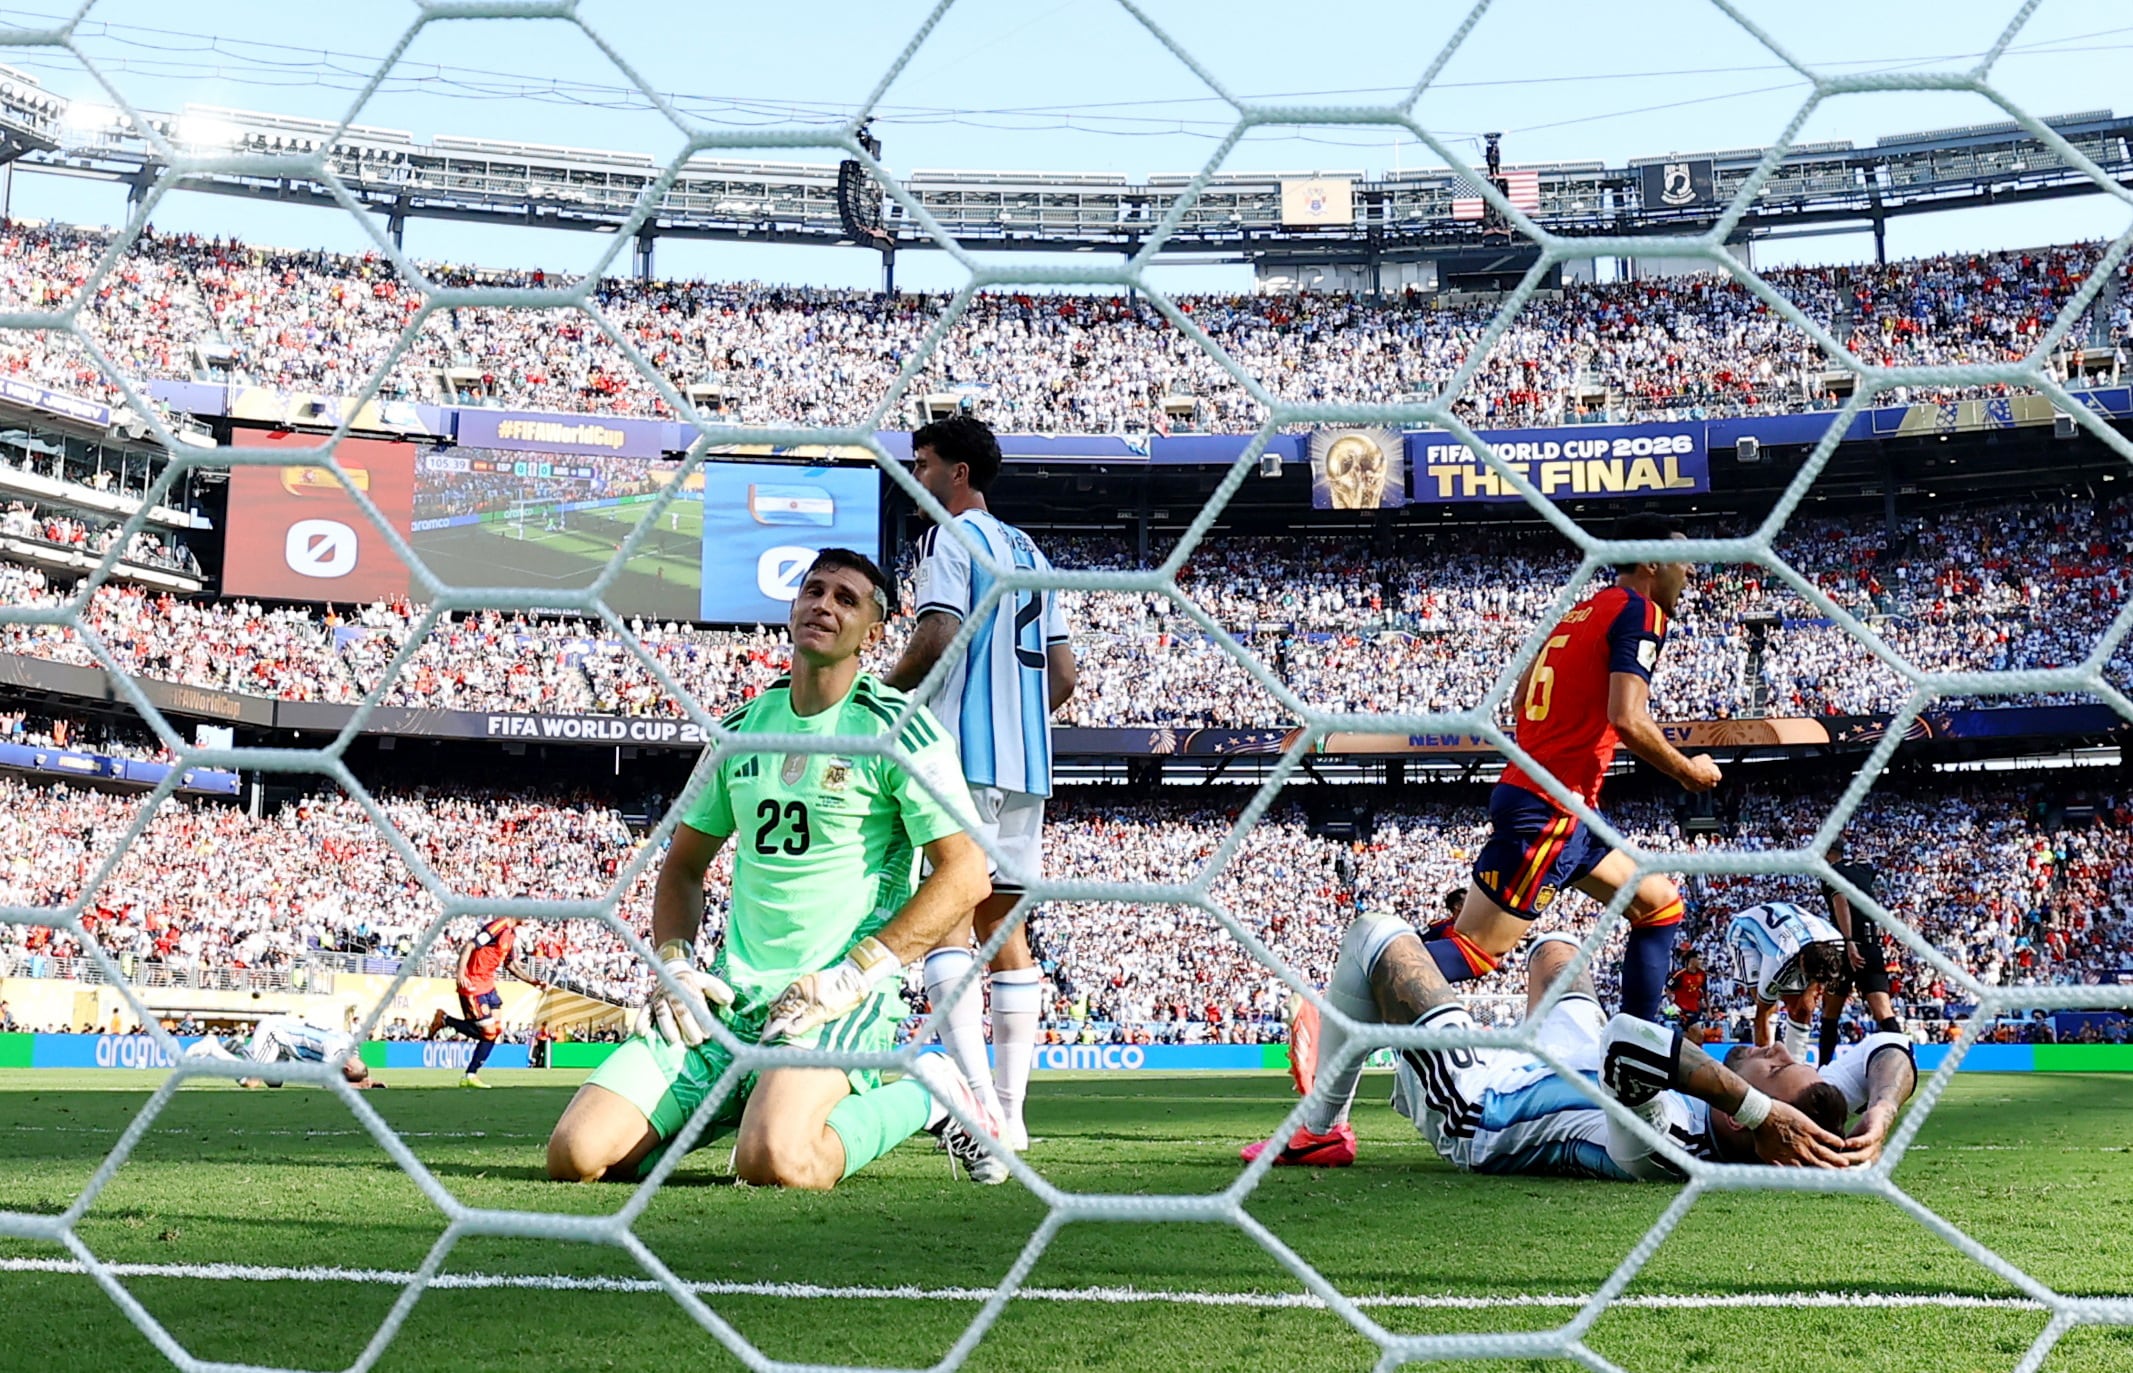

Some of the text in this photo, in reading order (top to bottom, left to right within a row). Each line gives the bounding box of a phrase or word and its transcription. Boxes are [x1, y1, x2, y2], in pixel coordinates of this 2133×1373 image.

[498, 419, 625, 450] #FIFAWorldCup
[1427, 443, 1476, 463] FIFA
[1563, 439, 1611, 459] CUP
[1612, 435, 1694, 456] 2026
[1428, 456, 1696, 498] THE FINAL
[1525, 634, 1571, 721] 6
[487, 716, 539, 737] FIFA
[542, 717, 627, 740] WORLD
[630, 721, 678, 742] CUP
[1409, 733, 1460, 746] NEW
[755, 798, 811, 856] 23
[423, 1042, 476, 1068] aramc
[1032, 1045, 1145, 1069] ramco
